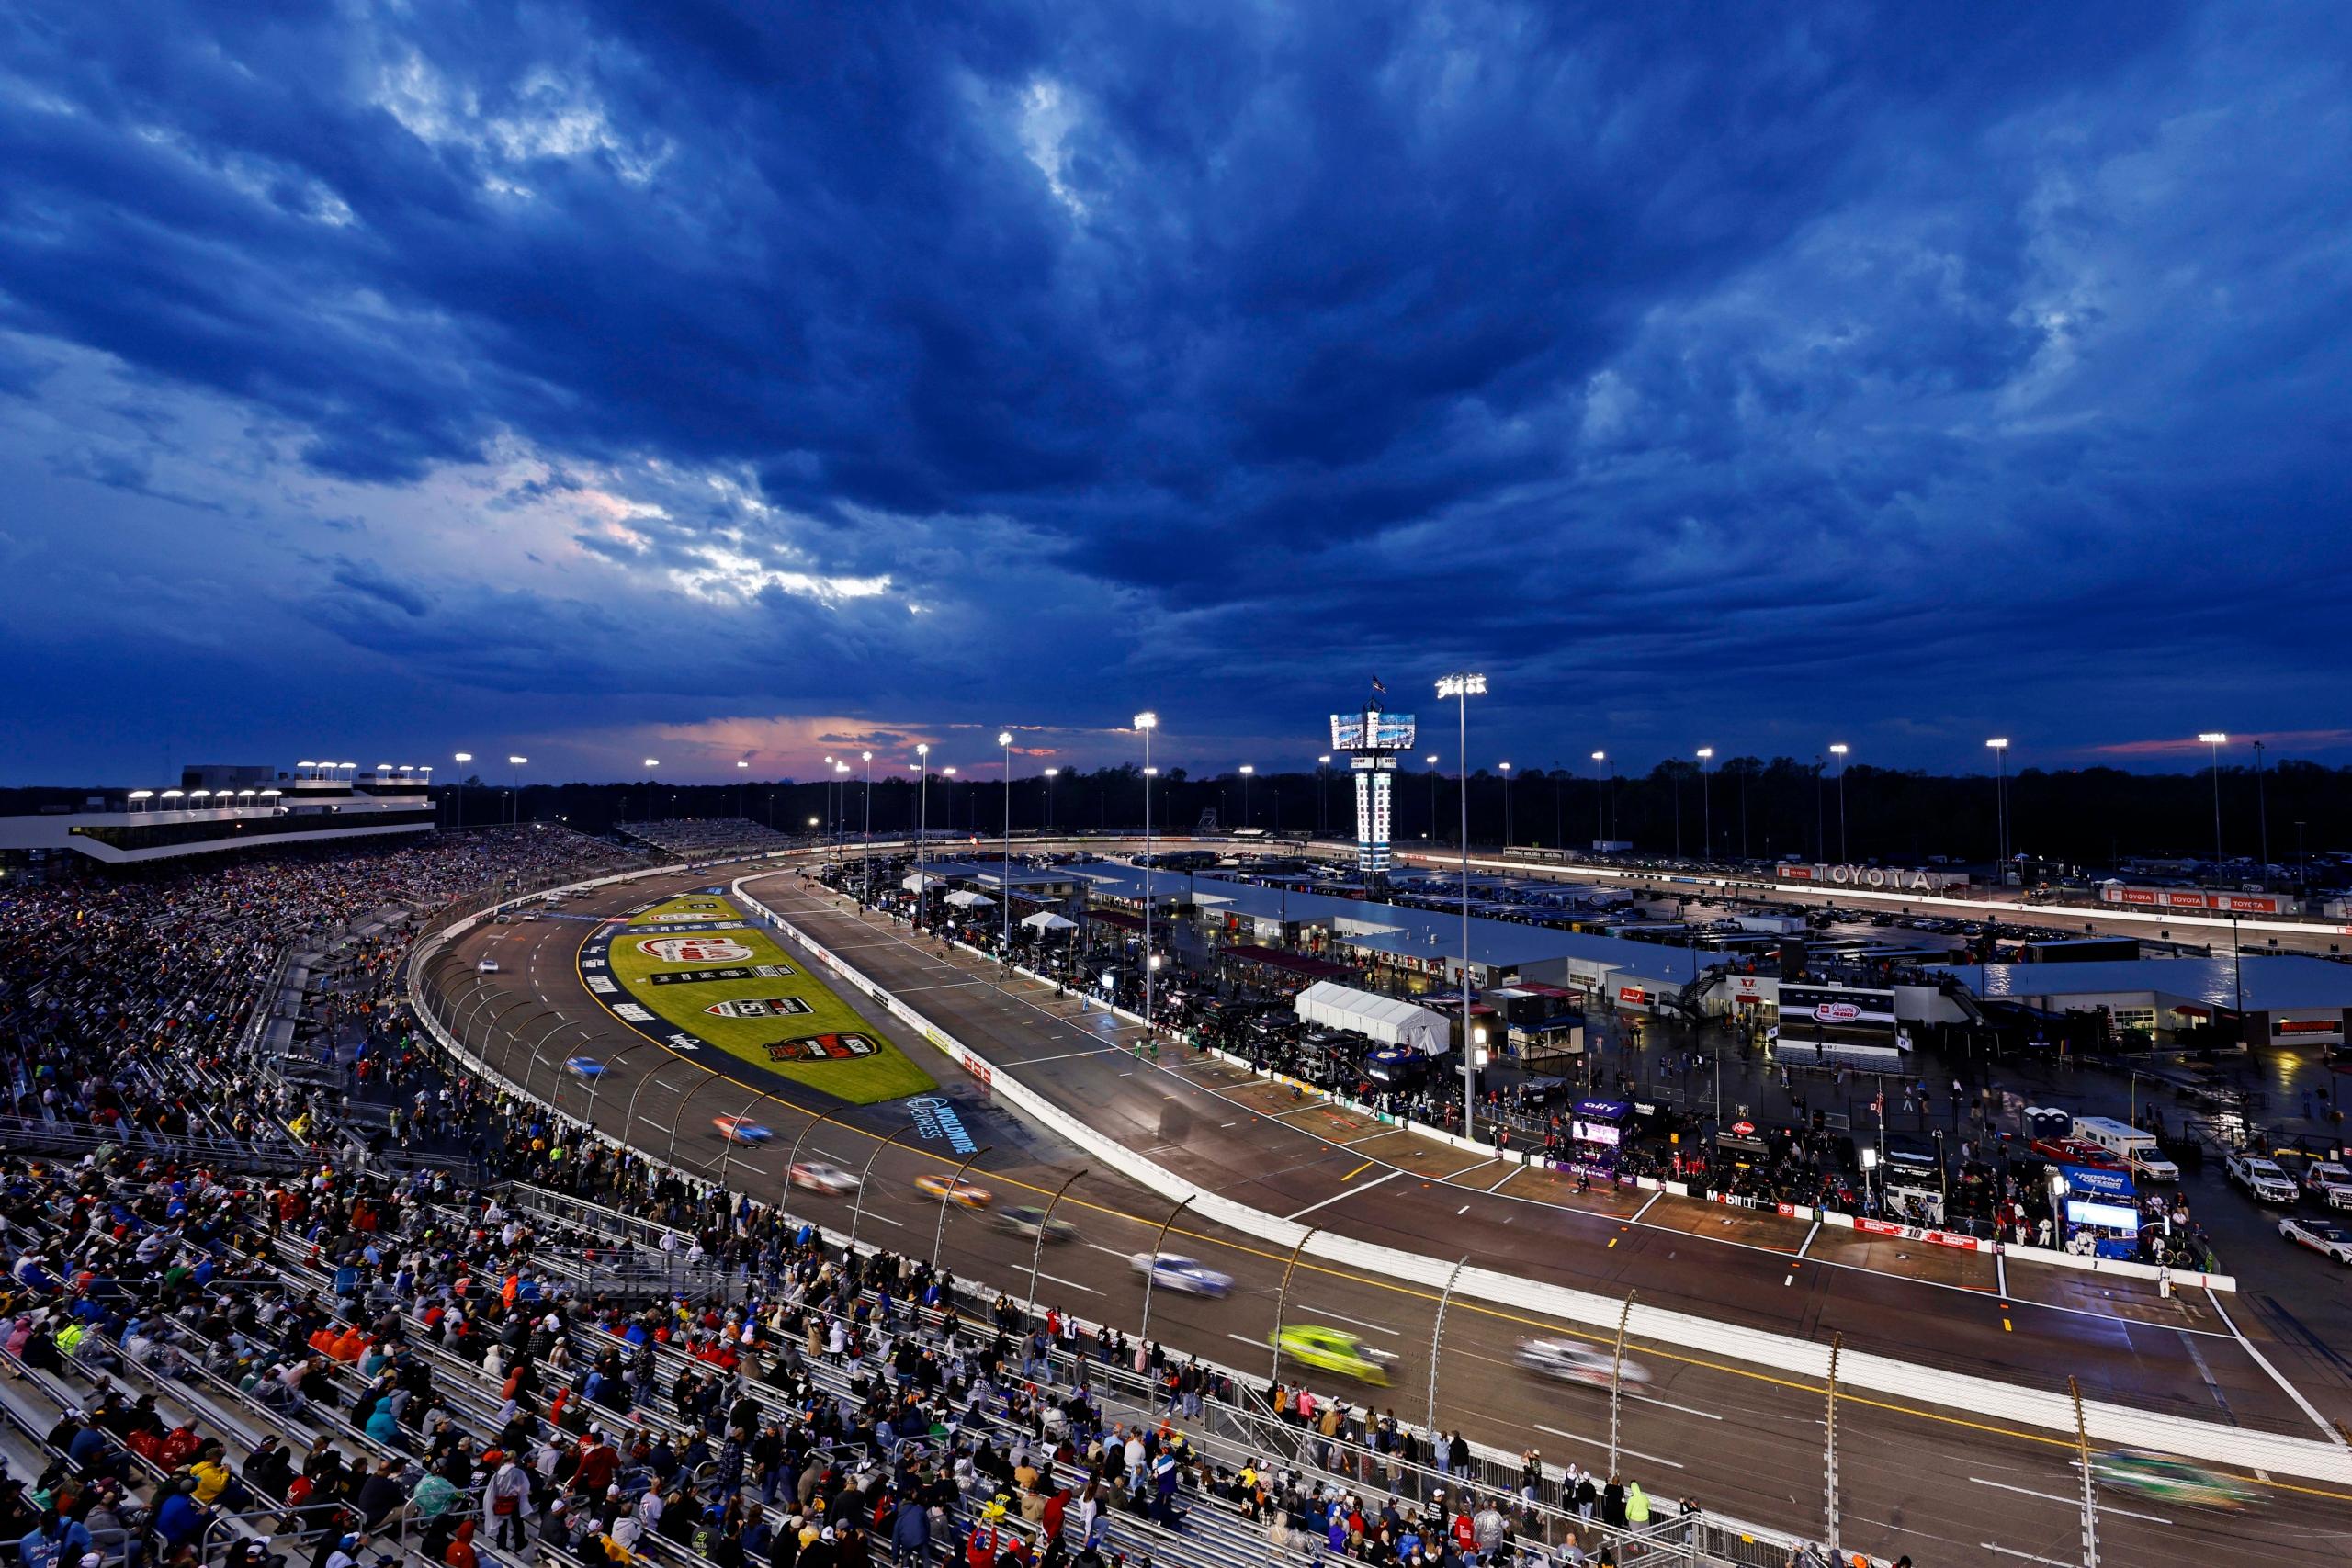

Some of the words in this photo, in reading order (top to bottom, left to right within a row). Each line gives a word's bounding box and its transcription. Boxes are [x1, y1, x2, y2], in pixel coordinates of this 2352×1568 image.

[1815, 863, 1931, 890] TOYOTA
[2124, 893, 2152, 901] TOYOTA
[2233, 900, 2264, 908] TOYOTA
[1583, 1102, 1618, 1112] ally
[910, 1108, 943, 1139] EXPRESS
[1733, 1122, 1754, 1133] Rheem
[933, 1107, 978, 1154] WORLDWIDE
[1546, 1160, 1557, 1169] 48
[1570, 1165, 1586, 1176] ally
[2074, 1172, 2124, 1184] Hendrick
[2083, 1179, 2121, 1189] Cars.com
[1706, 1190, 1742, 1206] Mobil
[1864, 1221, 1894, 1230] SUPERIOR
[1906, 1228, 1922, 1238] 10
[1943, 1235, 1974, 1244] SUPERIOR
[2093, 1261, 2098, 1269] 1
